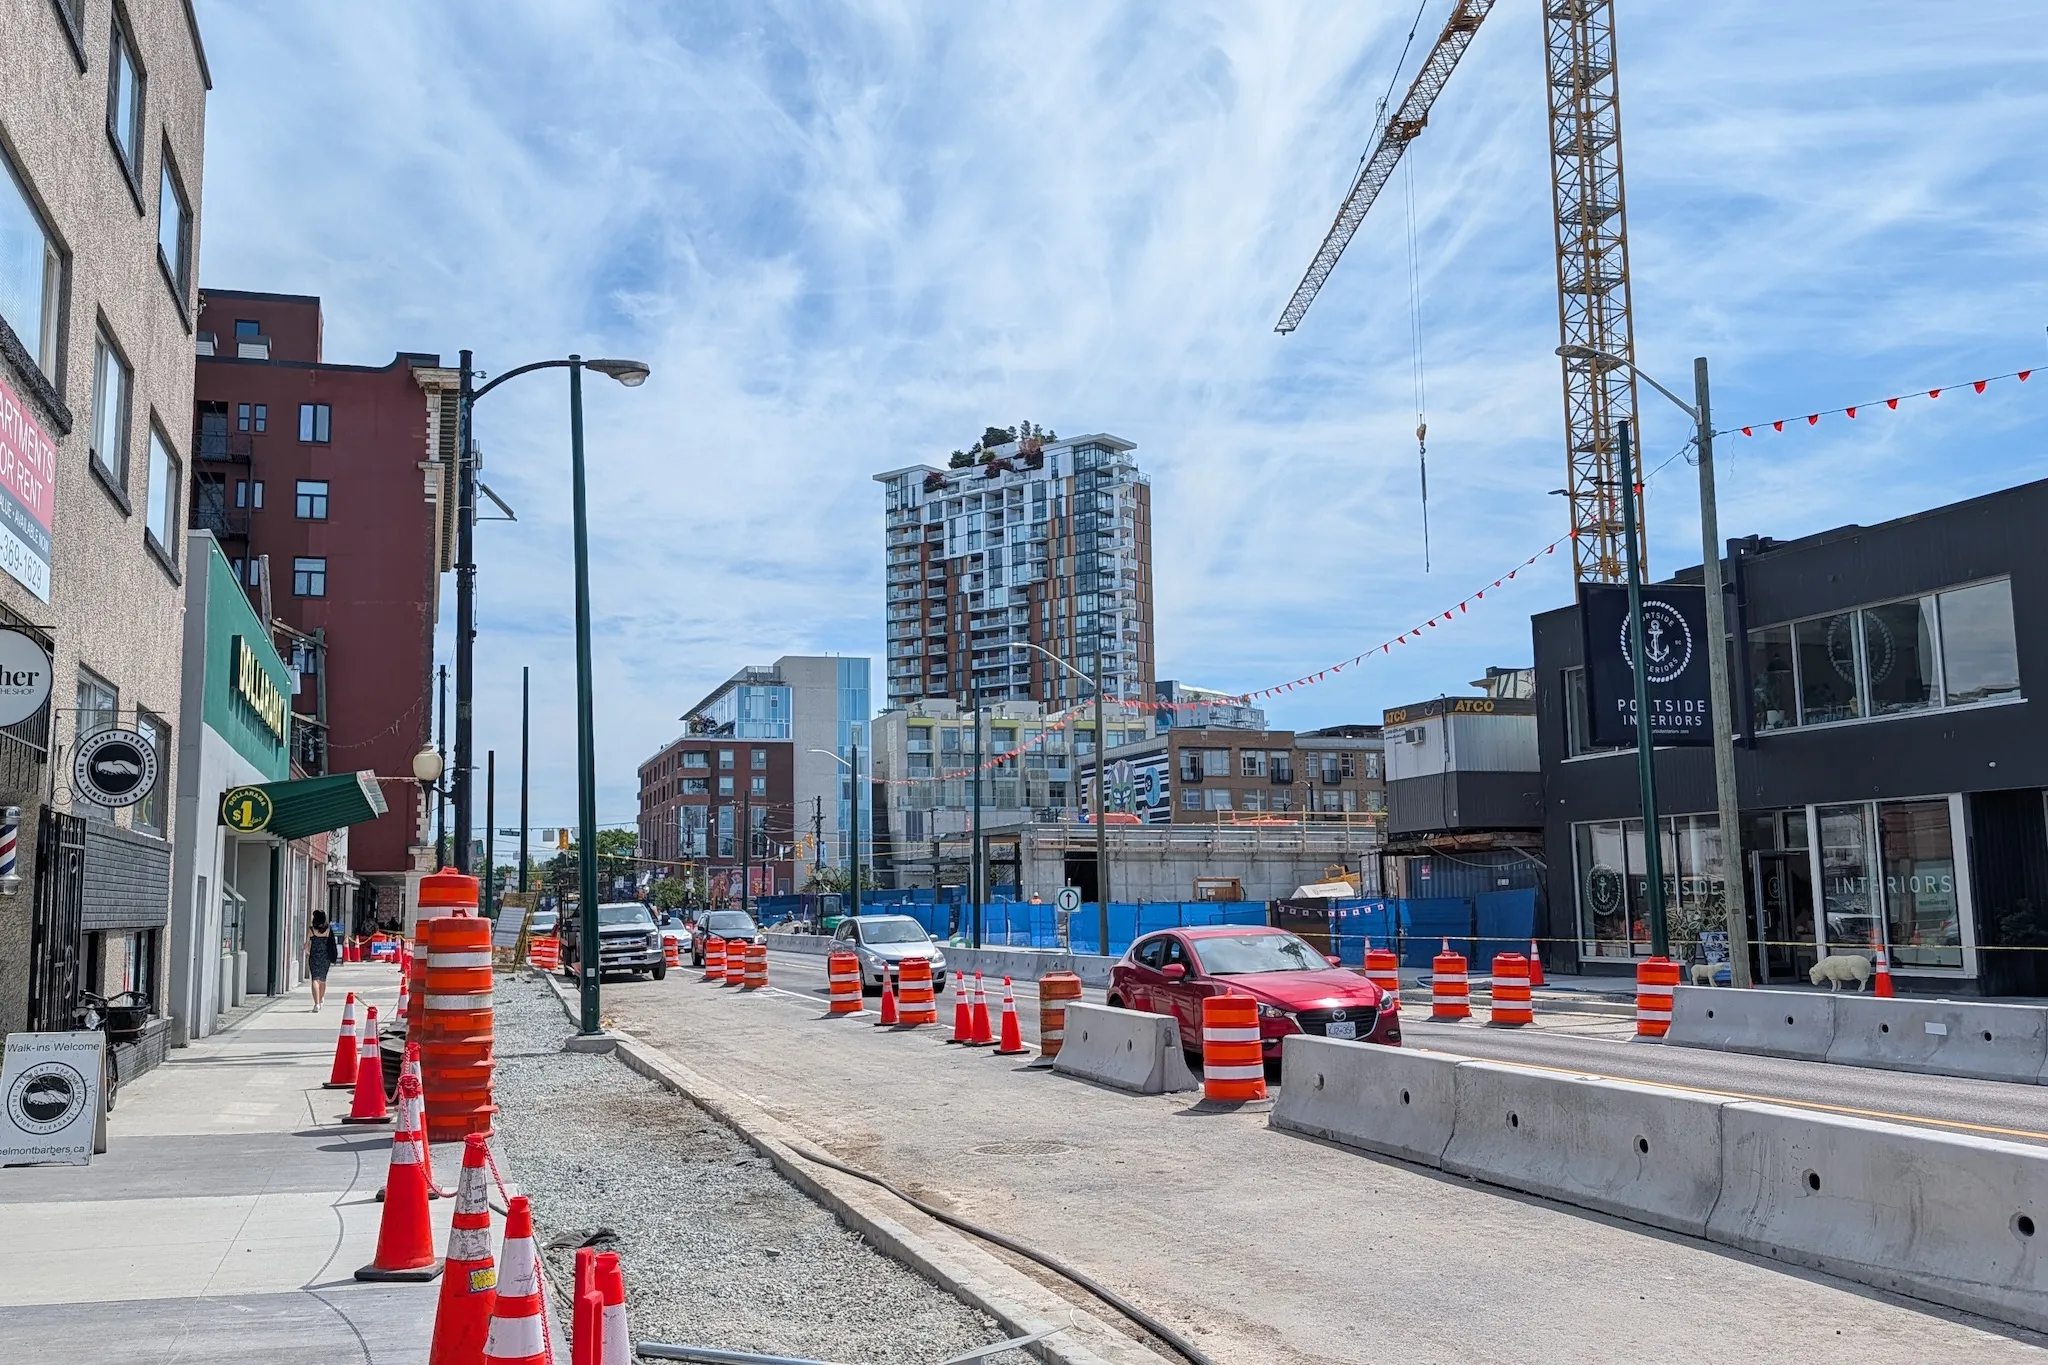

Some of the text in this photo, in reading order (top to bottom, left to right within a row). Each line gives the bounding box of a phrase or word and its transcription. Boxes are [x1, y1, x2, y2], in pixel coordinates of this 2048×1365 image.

[16, 459, 43, 512] RENT
[1455, 700, 1495, 712] ATCO
[1617, 699, 1706, 713] POTSIDE
[1385, 709, 1407, 724] ATCO
[1623, 714, 1703, 726] INERIORS
[81, 733, 117, 758] BELMONT
[123, 733, 155, 781] BARBERSHOP
[84, 784, 129, 804] VANCOUVER
[228, 790, 266, 807] DOLLARAMA
[7, 1042, 100, 1053] Walk-ins Welcome
